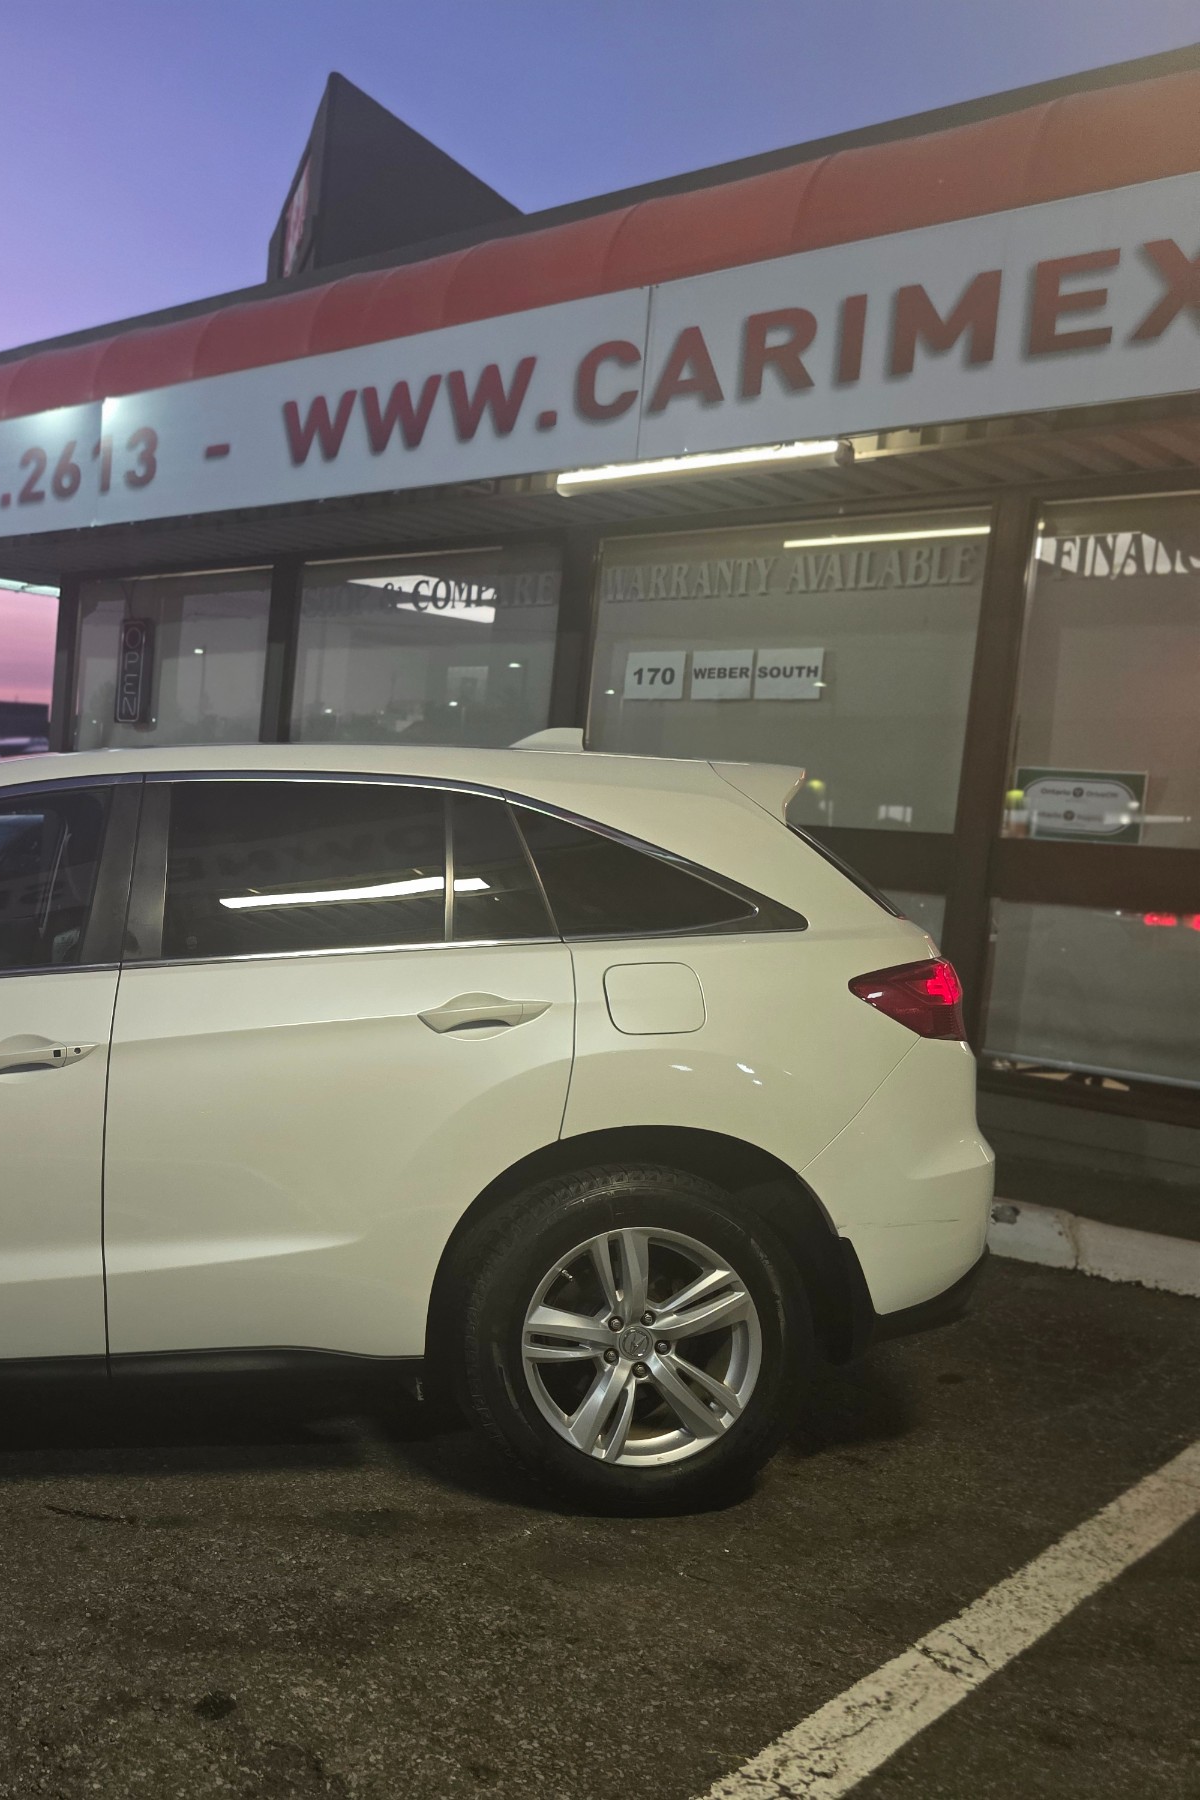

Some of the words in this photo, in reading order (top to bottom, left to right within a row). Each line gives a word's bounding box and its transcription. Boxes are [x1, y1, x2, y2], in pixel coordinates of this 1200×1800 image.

[604, 557, 780, 603] WARRANTY
[786, 543, 981, 595] AVAILABLE
[122, 626, 142, 717] OPEN
[633, 667, 676, 686] 170
[693, 666, 750, 680] WEBER
[757, 665, 819, 679] SOUTH
